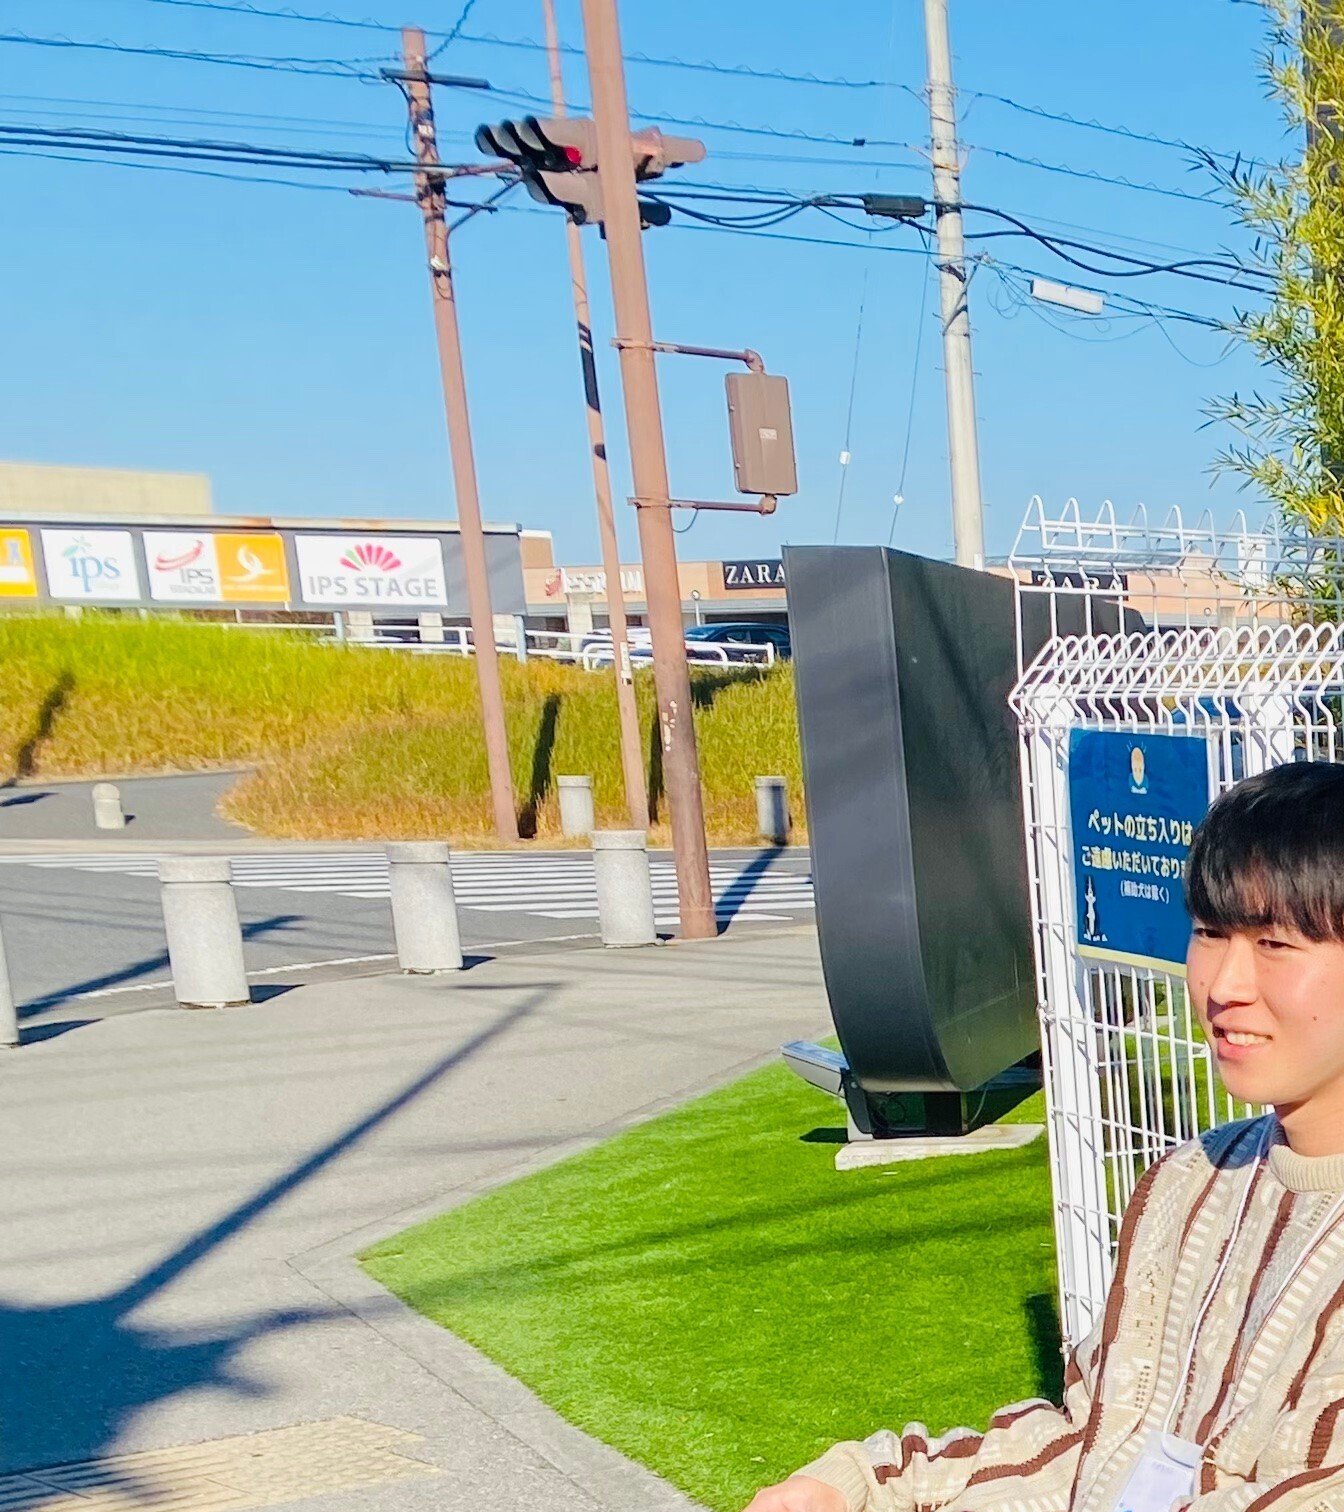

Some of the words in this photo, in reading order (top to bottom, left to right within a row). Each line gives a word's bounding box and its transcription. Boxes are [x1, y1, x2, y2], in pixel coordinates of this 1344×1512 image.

[70, 554, 121, 593] ips
[309, 575, 347, 596] IPS
[355, 576, 439, 598] STAGE
[725, 564, 785, 584] ZARA
[1088, 808, 1193, 846] ペットの立ち入りは
